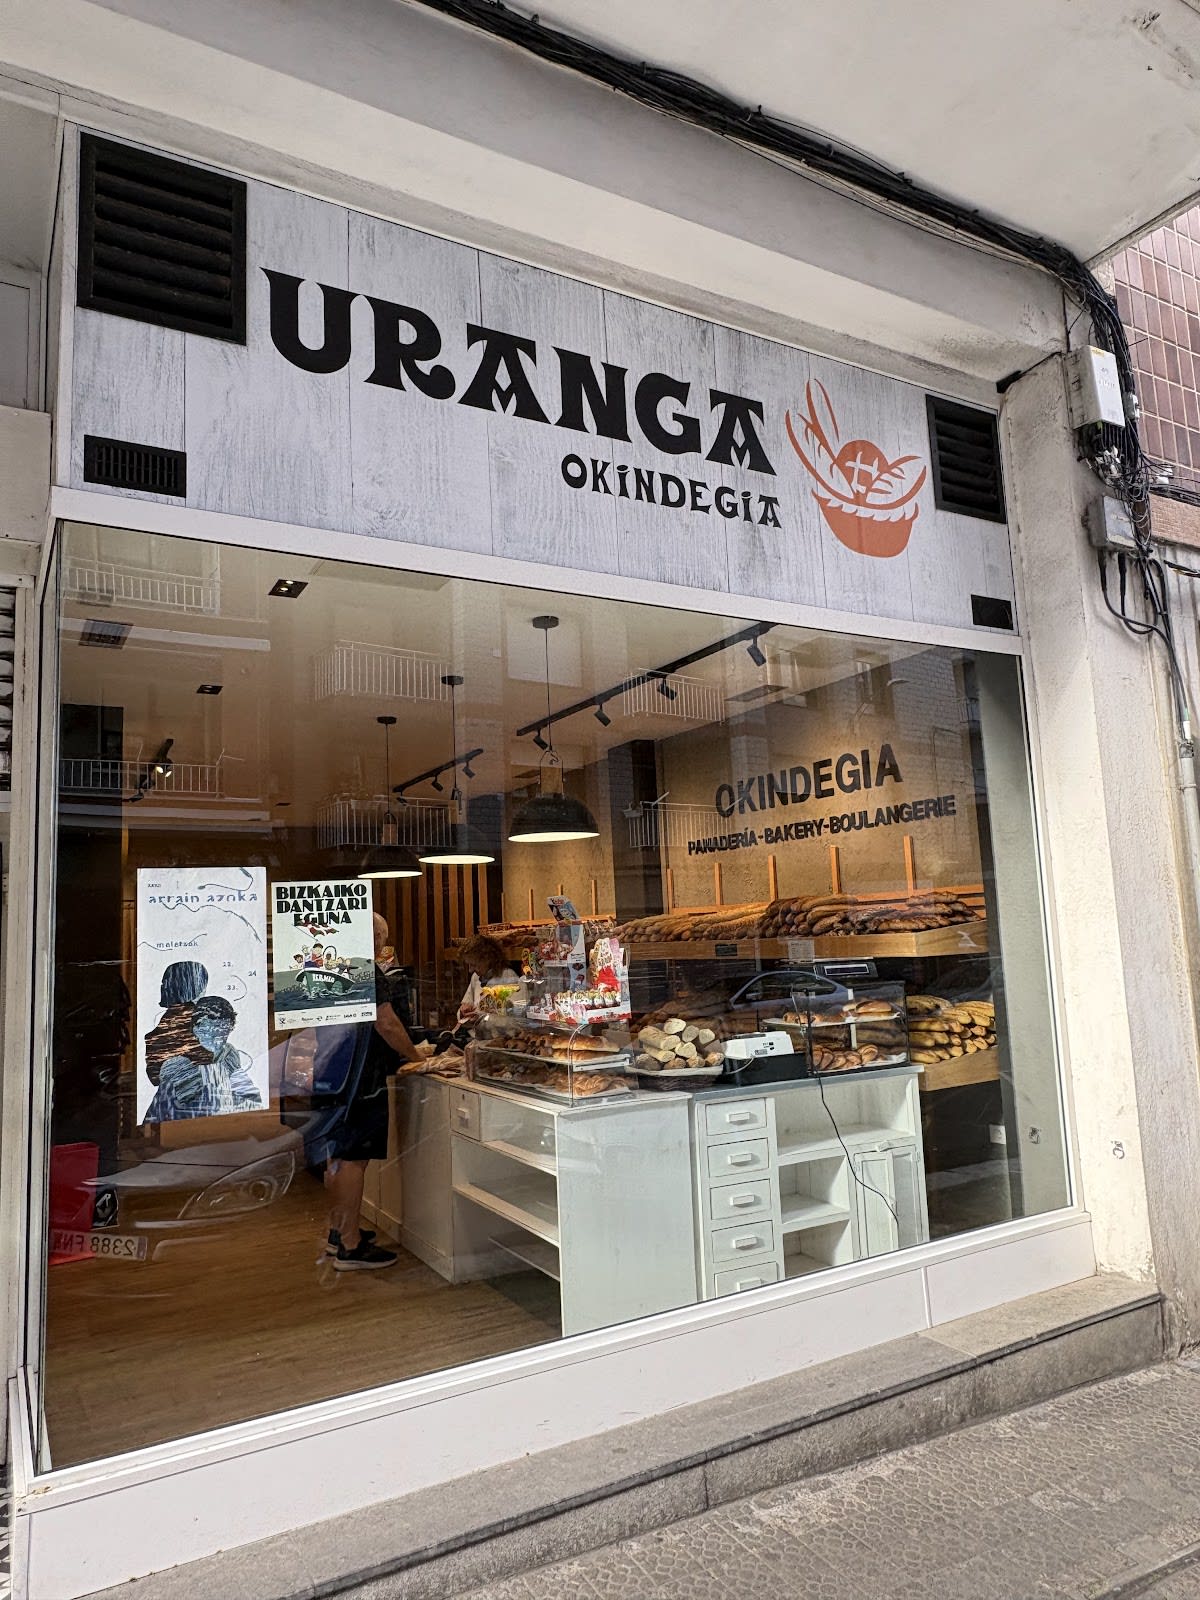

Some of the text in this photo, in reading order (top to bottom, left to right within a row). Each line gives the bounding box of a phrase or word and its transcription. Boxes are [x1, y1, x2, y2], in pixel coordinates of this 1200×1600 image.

[259, 266, 777, 476] URANGA
[715, 743, 904, 818] OKINDEGIA
[275, 883, 367, 900] BIZKAIKO
[276, 897, 368, 914] DANTZARI
[293, 911, 353, 927] EGUNA
